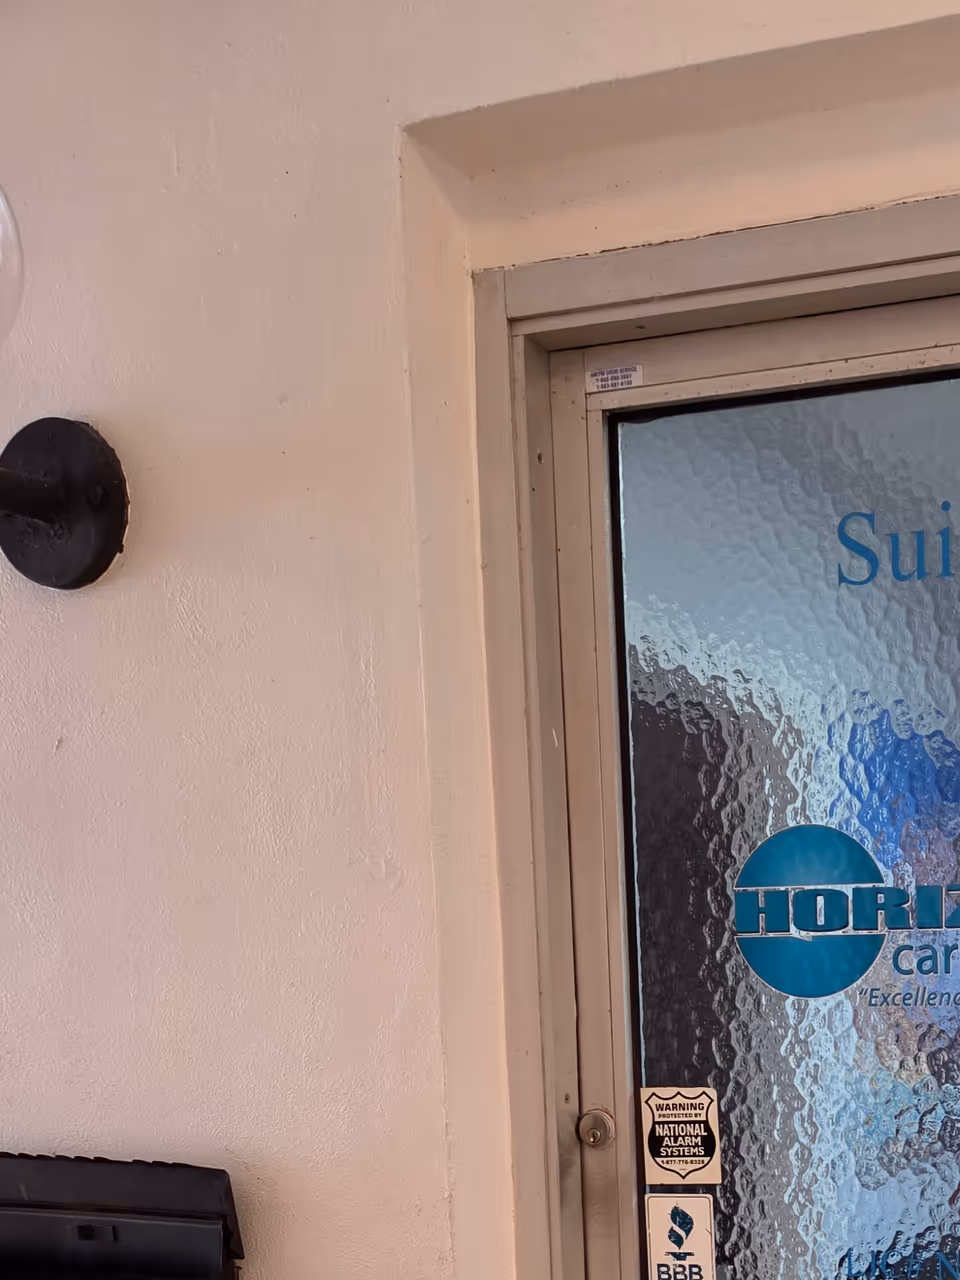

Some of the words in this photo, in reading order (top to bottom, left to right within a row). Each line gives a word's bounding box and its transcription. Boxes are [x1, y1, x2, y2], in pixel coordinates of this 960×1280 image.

[655, 1103, 705, 1112] WARNING
[655, 1124, 708, 1136] NATIONAL
[662, 1136, 702, 1146] ALARM
[660, 1146, 704, 1156] SYSTEMS
